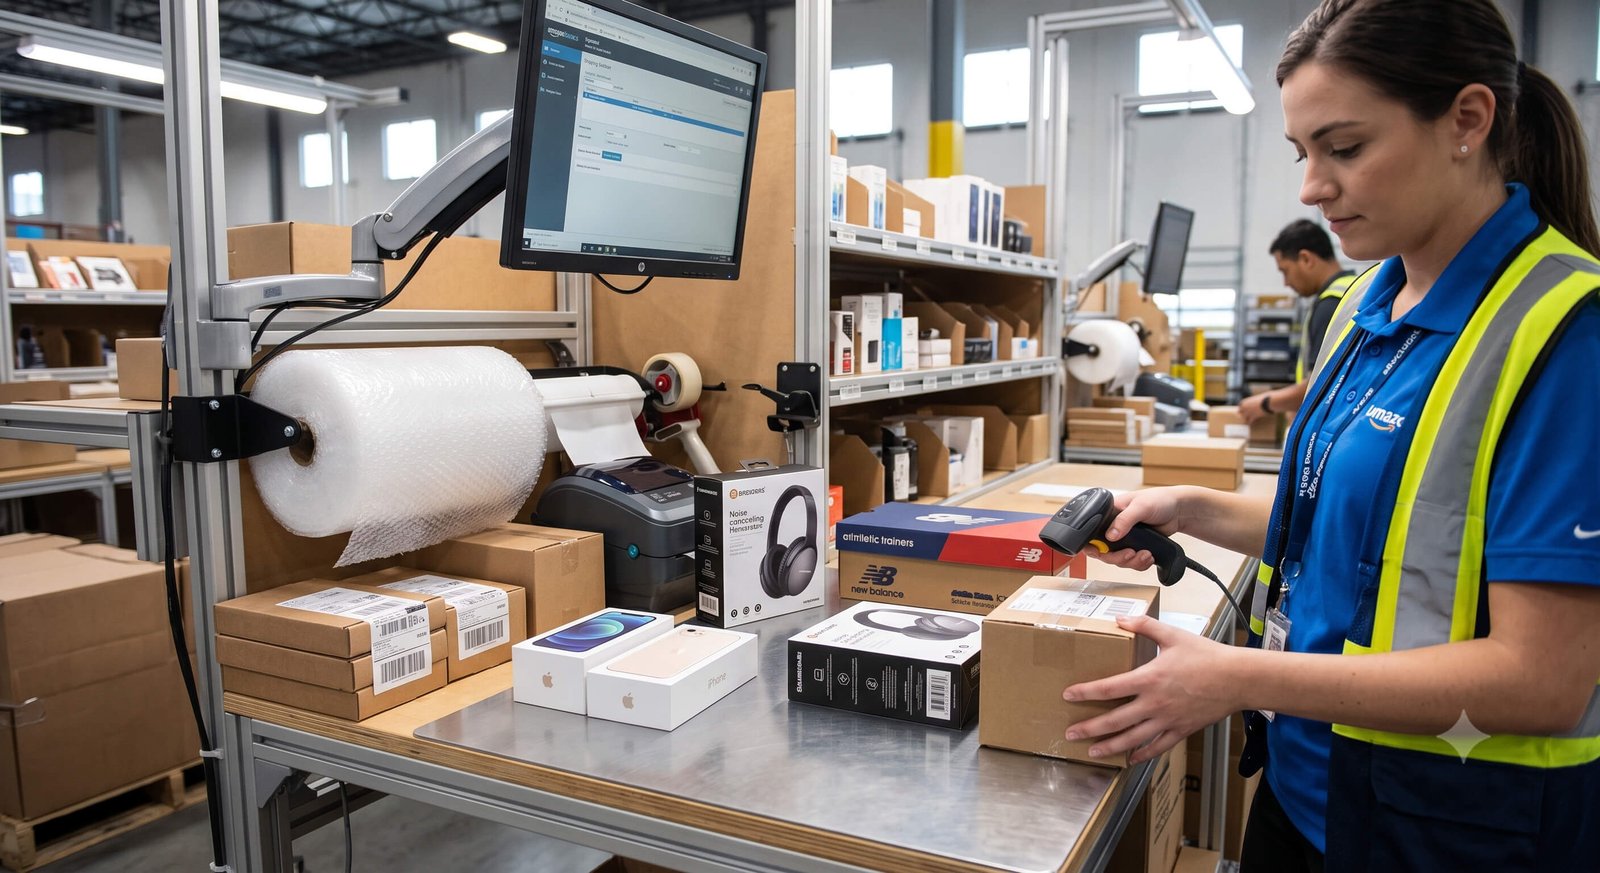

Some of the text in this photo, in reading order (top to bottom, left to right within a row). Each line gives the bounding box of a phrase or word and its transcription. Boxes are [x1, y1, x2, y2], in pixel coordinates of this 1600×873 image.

[729, 509, 748, 518] Noise
[880, 536, 914, 548] trainers
[851, 586, 904, 599] new balance
[707, 671, 727, 690] iPhone
